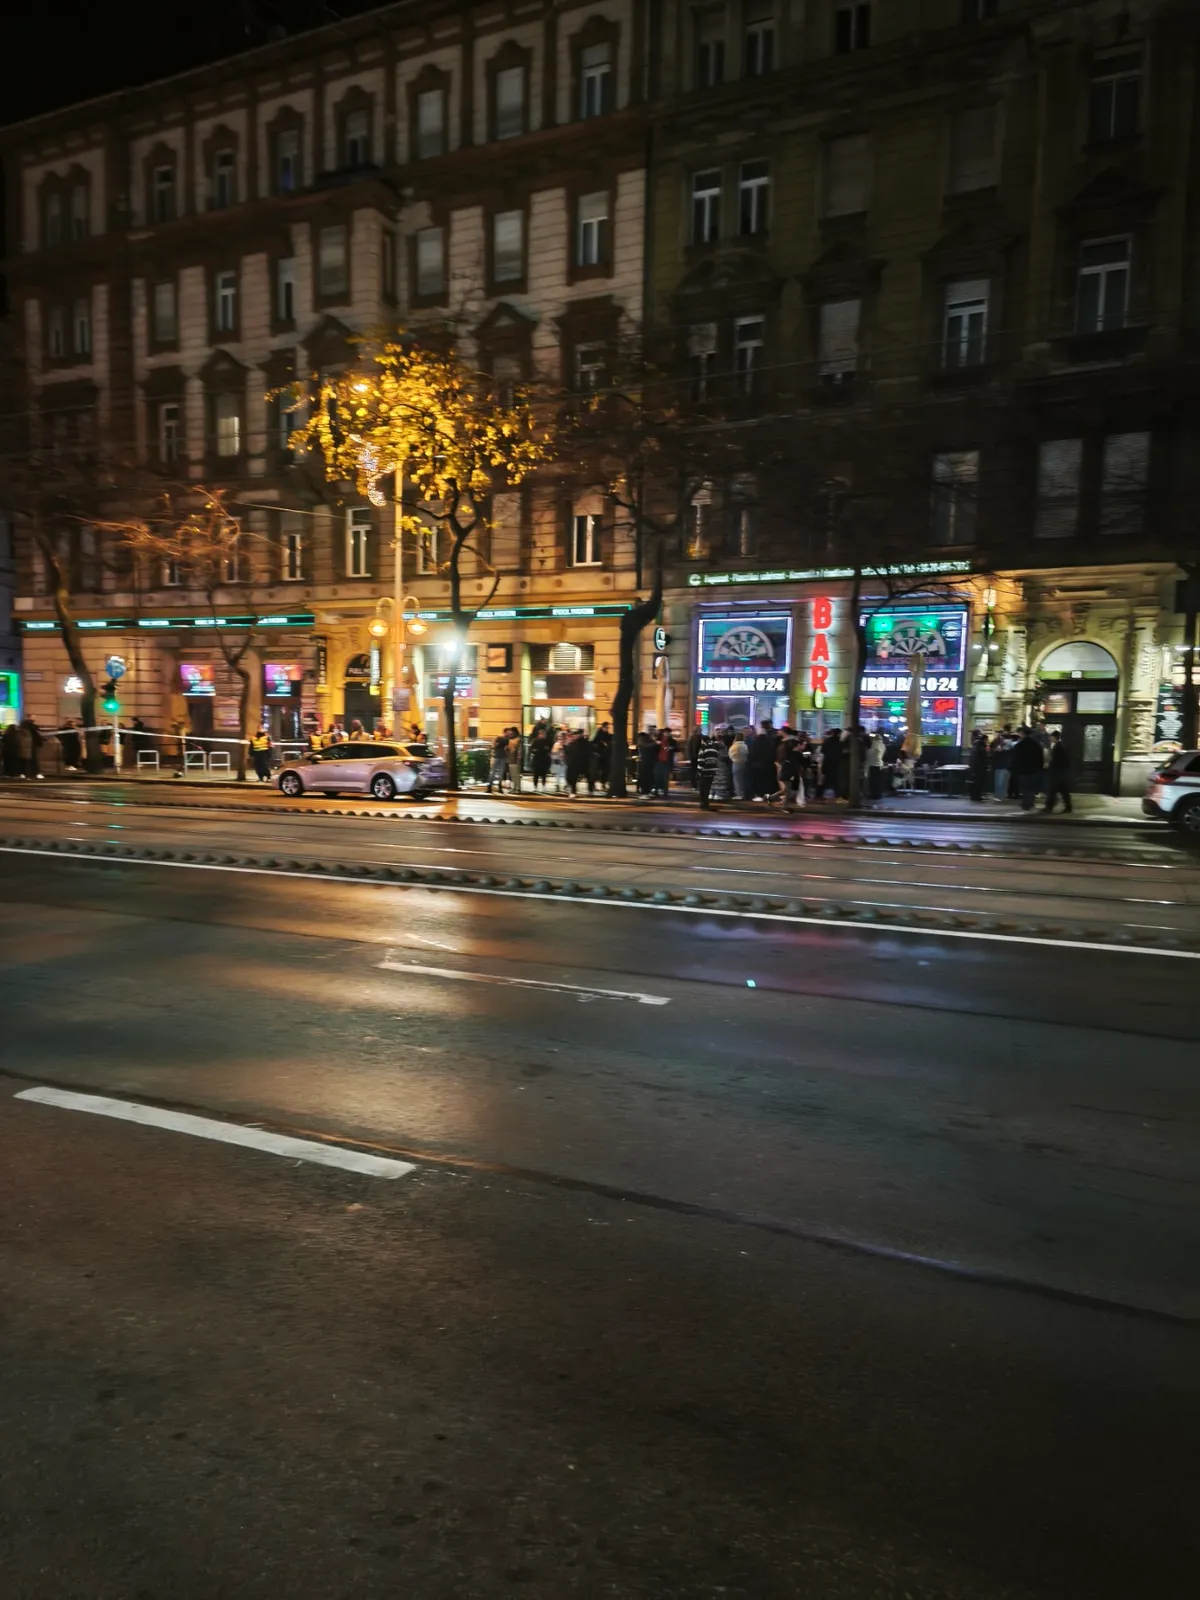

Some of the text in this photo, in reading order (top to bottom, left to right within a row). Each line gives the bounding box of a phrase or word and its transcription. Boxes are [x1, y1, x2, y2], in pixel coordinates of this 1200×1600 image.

[810, 596, 832, 693] BAR
[699, 677, 784, 691] IRON BAR 0-24
[860, 676, 897, 691] IRON
[926, 676, 959, 691] 0-24
